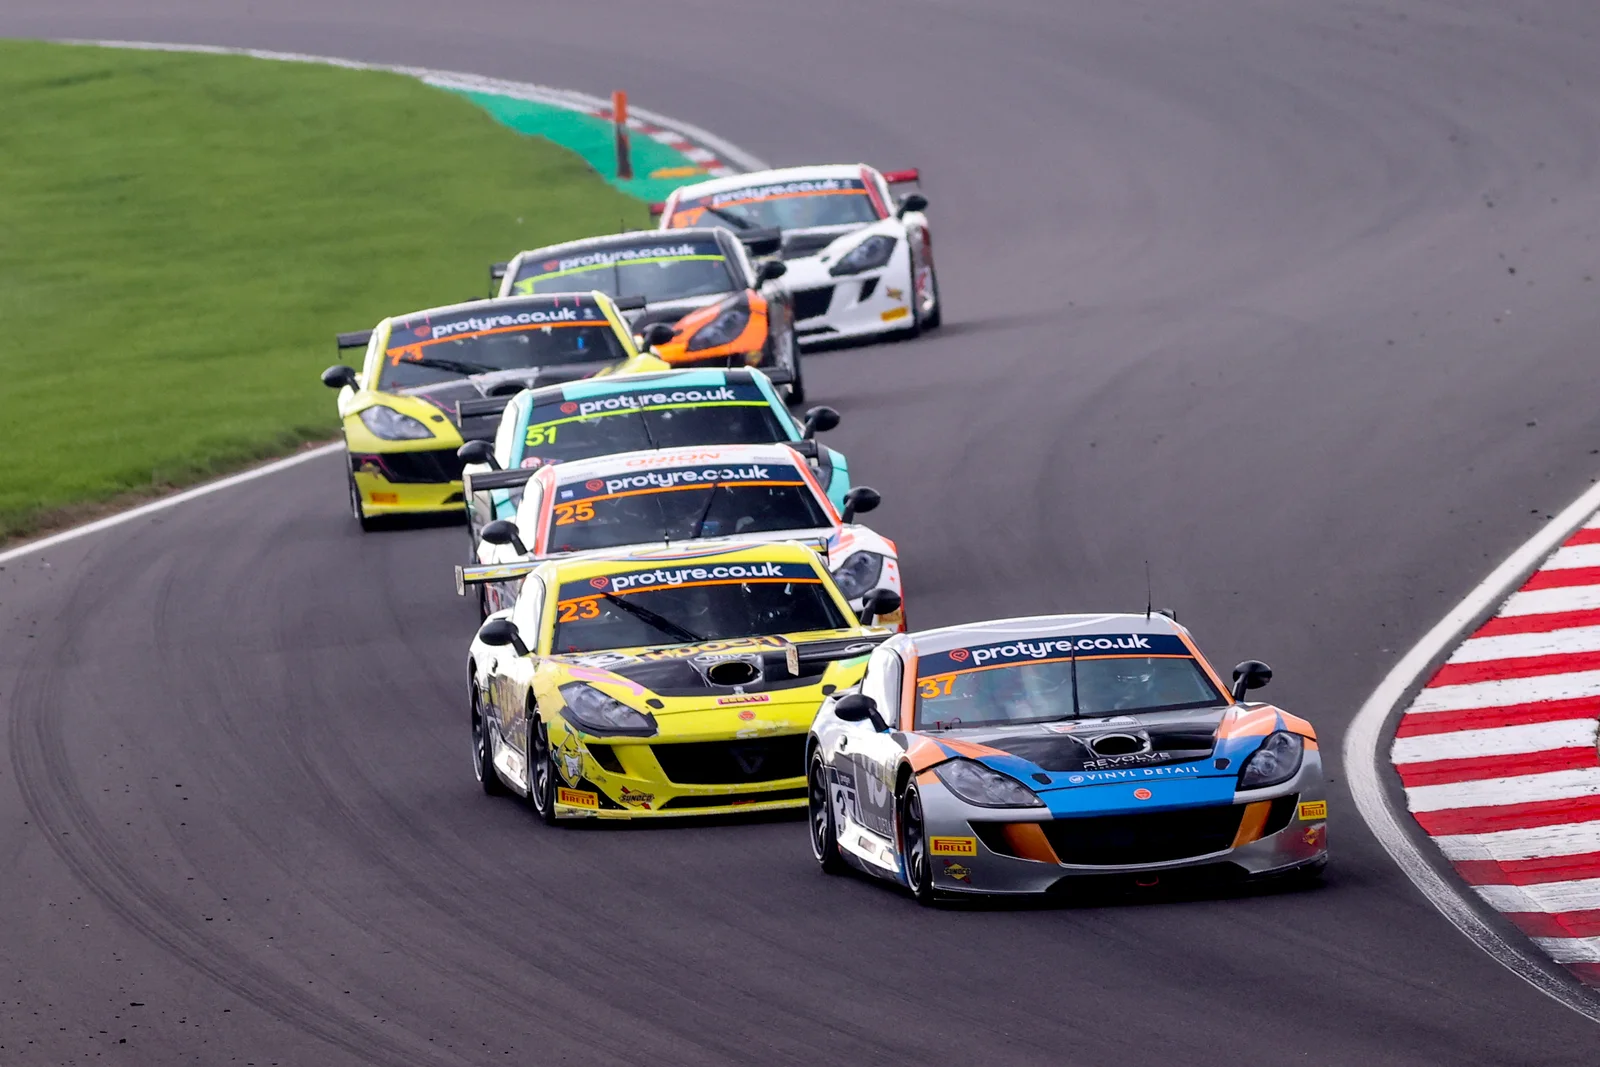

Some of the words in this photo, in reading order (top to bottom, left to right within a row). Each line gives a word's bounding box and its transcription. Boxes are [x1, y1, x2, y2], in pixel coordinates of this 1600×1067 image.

[559, 243, 696, 272] protyre.co.uk
[432, 307, 577, 340] protyre.co.uk
[579, 386, 736, 415] protyre.co.uk
[525, 426, 557, 447] 51
[606, 465, 769, 494] protyre.co.uk
[554, 502, 595, 526] 25
[612, 562, 783, 592] protyre.co.uk
[558, 598, 600, 623] 23
[972, 633, 1152, 667] protyre.co.uk
[918, 674, 958, 699] 37
[1083, 752, 1171, 769] REVOLVE
[1087, 770, 1136, 781] VINYL
[1143, 766, 1199, 776] DETAIL
[562, 790, 595, 806] PIRELLI
[934, 839, 972, 852] PIRELLI
